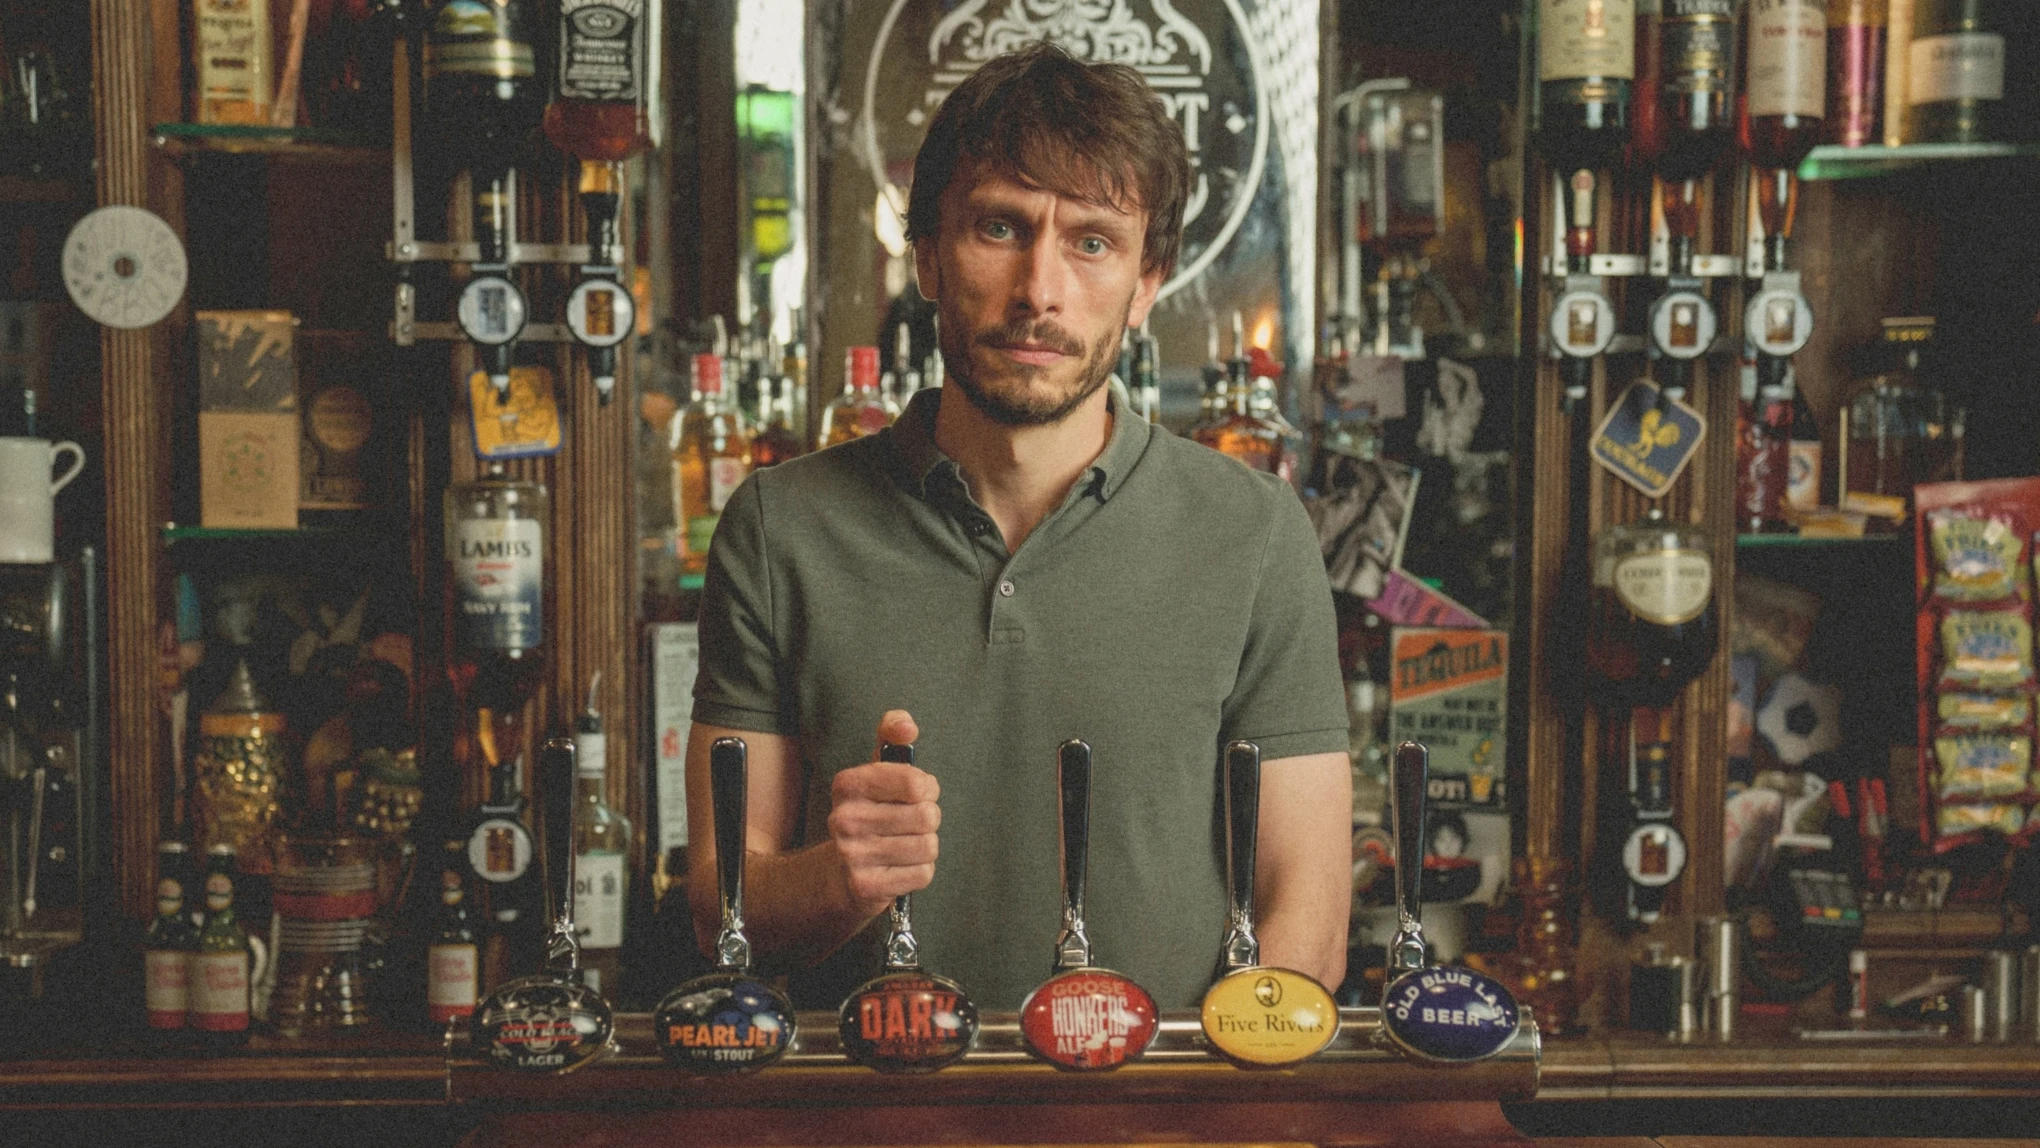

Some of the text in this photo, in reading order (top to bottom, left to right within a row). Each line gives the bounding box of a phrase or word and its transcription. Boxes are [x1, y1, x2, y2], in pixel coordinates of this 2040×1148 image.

[1399, 637, 1501, 690] TEQUILA
[1051, 980, 1126, 997] GOOSE
[1395, 972, 1507, 1028] OLD BLUE LAST
[859, 993, 959, 1041] DARK
[1051, 995, 1130, 1037] HONKERS
[1217, 1013, 1258, 1033] Five
[1422, 1007, 1480, 1027] BEER
[668, 1024, 781, 1047] PEARL JET
[1057, 1036, 1087, 1054] ALE
[518, 1053, 565, 1066] LAGER
[713, 1048, 755, 1062] STOUT
